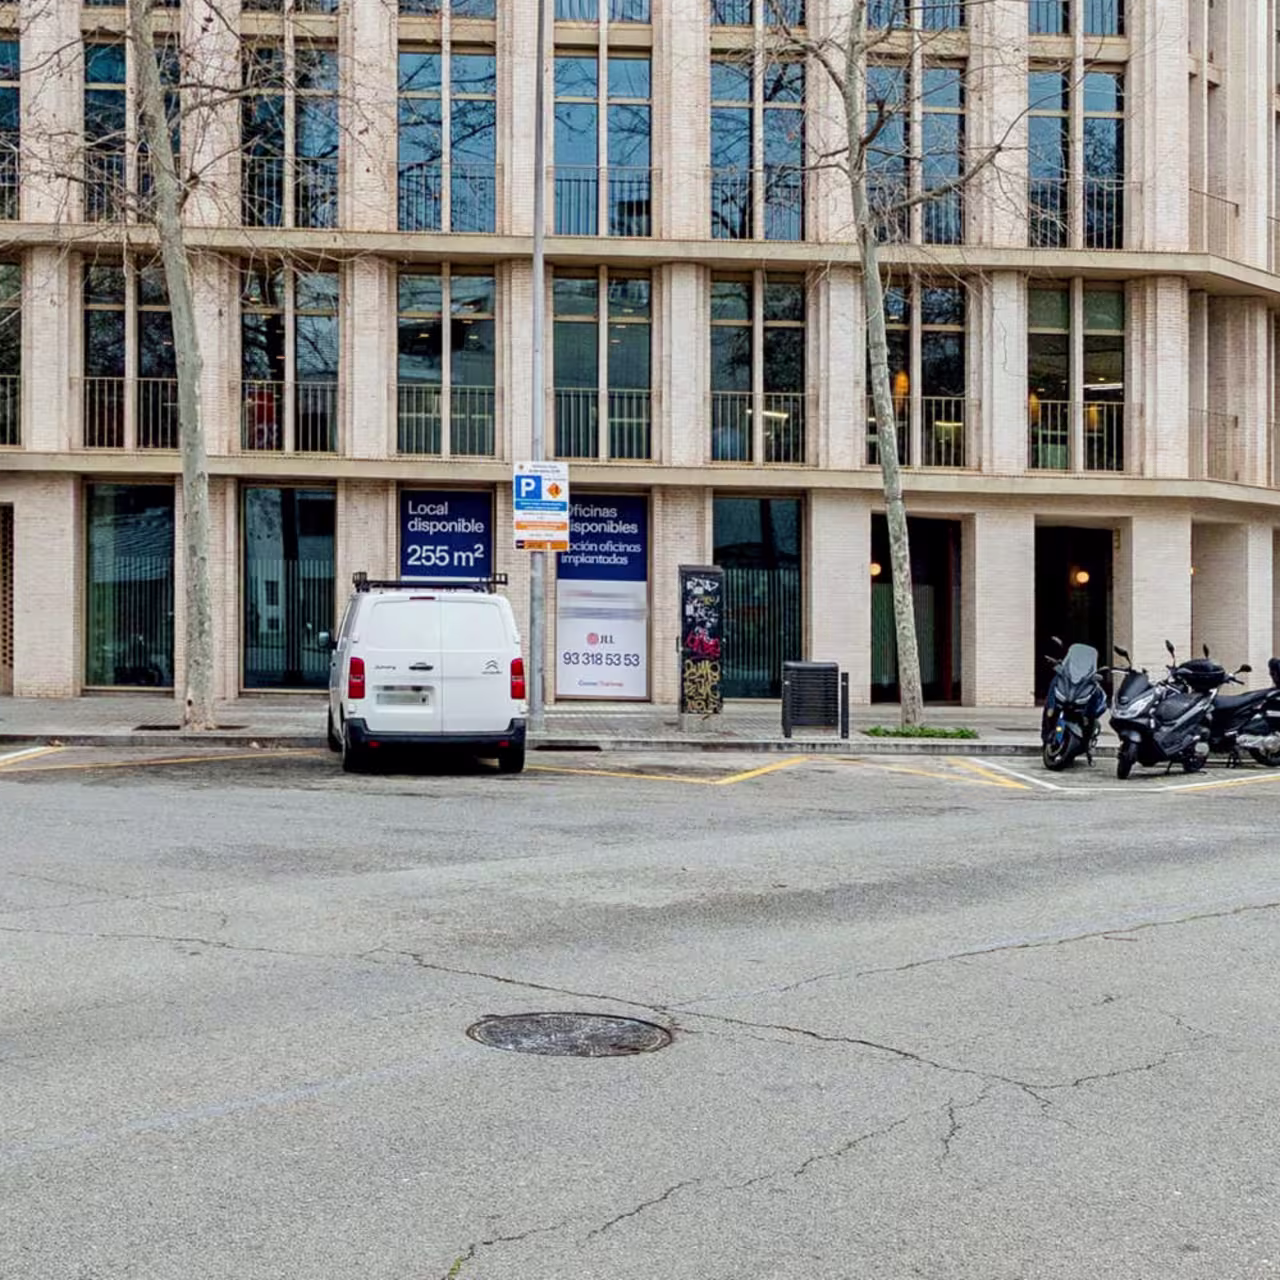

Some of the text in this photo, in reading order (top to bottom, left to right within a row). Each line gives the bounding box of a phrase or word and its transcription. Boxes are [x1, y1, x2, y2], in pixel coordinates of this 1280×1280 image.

[520, 477, 536, 498] P
[408, 500, 449, 515] Local
[407, 517, 484, 535] disponible
[569, 519, 638, 535] isponibles
[568, 540, 598, 553] pción
[599, 540, 642, 553] oficinas
[407, 544, 450, 566] 255
[561, 553, 628, 567] implantadas
[600, 634, 615, 644] JLL
[562, 651, 640, 667] 93 318 53 53
